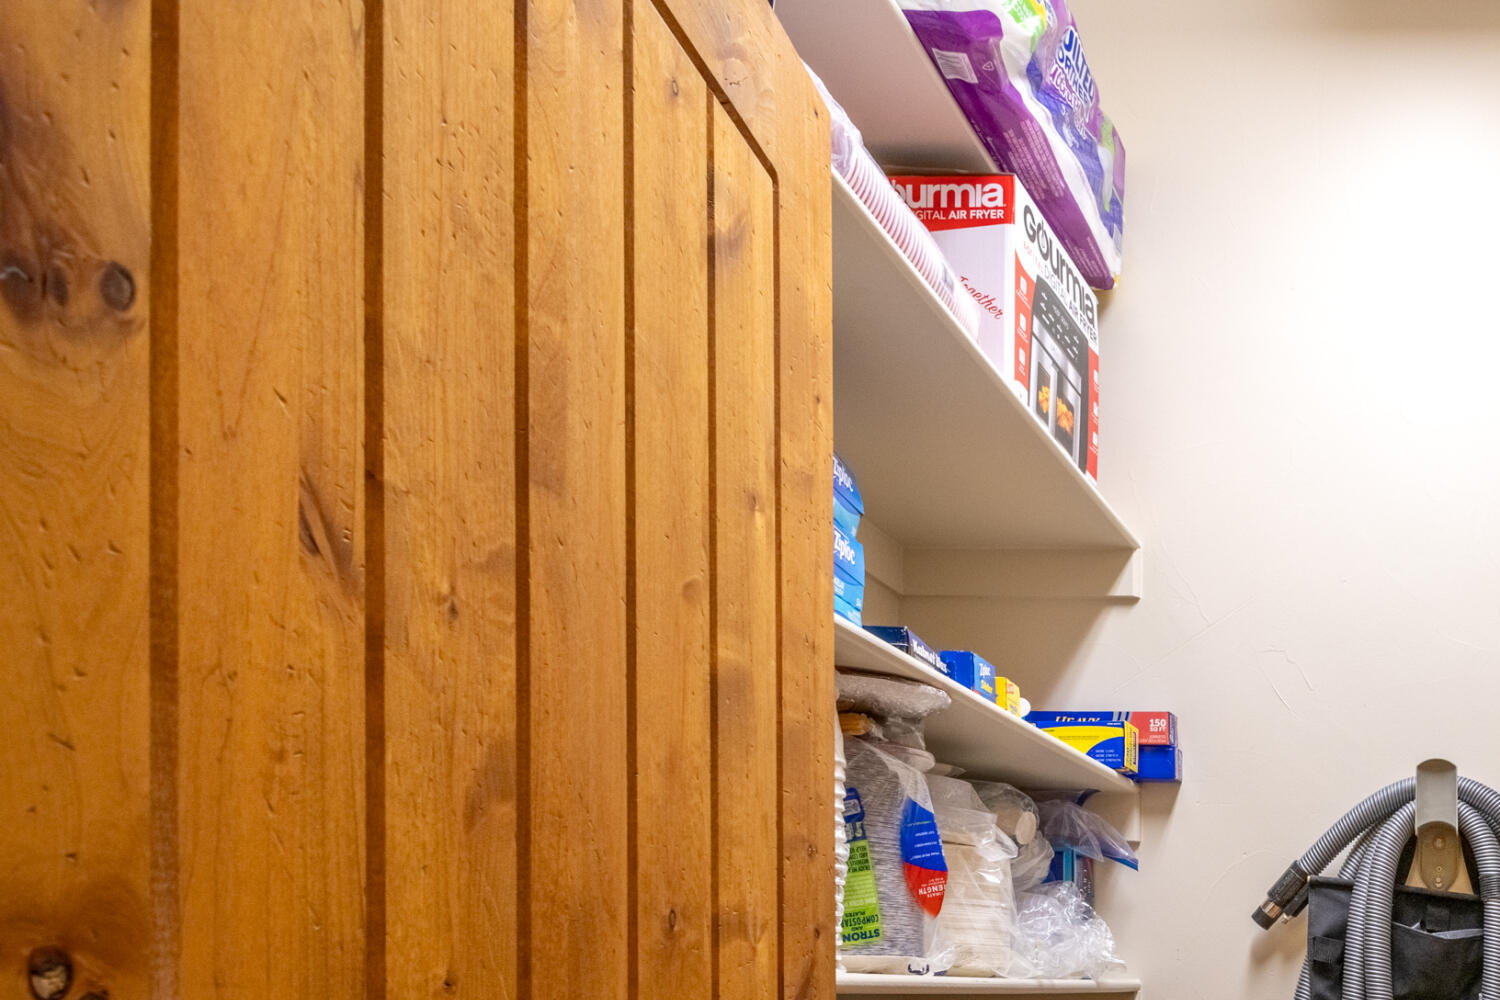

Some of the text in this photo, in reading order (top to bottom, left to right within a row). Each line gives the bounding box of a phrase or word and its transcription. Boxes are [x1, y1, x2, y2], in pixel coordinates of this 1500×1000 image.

[911, 209, 1005, 221] GITAL AIR FRYER
[1023, 204, 1095, 328] Gourmia
[833, 530, 856, 565] Ziploc
[1149, 718, 1167, 728] 150
[842, 928, 881, 942] STRON
